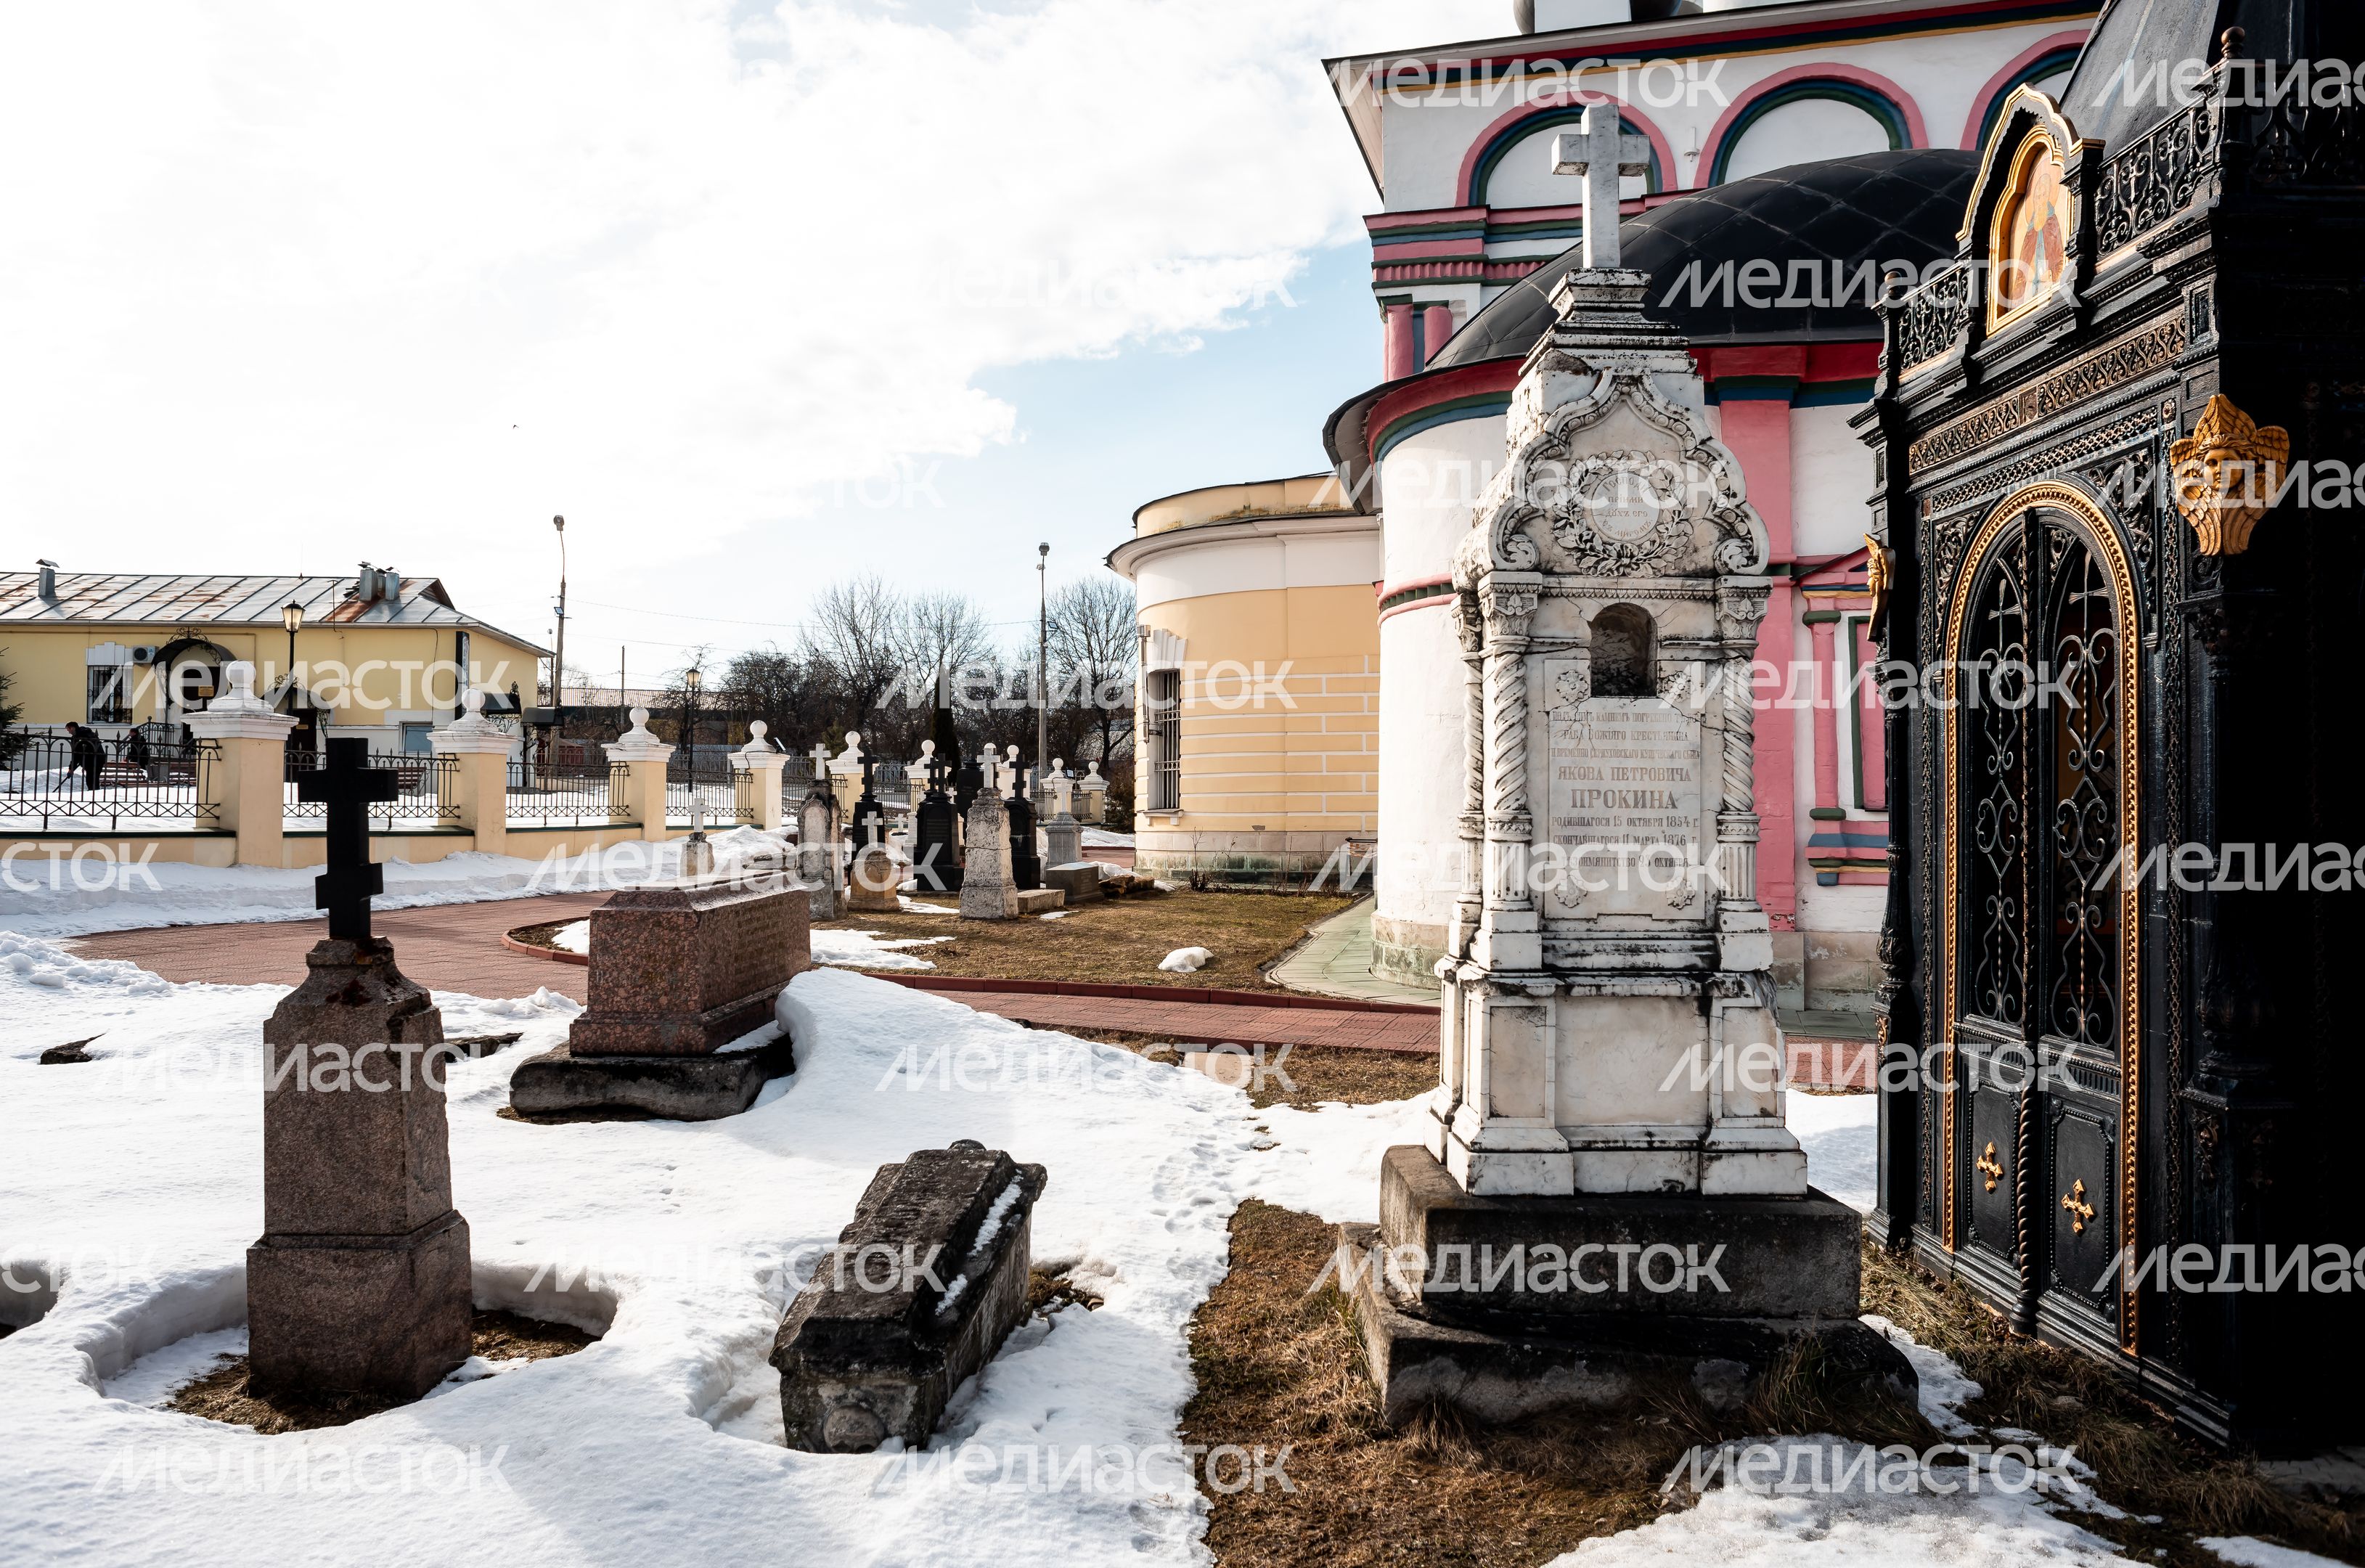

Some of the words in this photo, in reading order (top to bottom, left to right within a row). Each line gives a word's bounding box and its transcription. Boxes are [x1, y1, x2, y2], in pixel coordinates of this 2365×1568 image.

[1557, 766, 1605, 780] ЯКОВА
[1610, 767, 1692, 782] ПЕТРОВИЧА
[1571, 789, 1678, 809] ПРОКИНА
[1626, 817, 1664, 827] ОКТЯБРЯ
[1666, 815, 1690, 828] 1854
[1633, 836, 1659, 845] МАРТА
